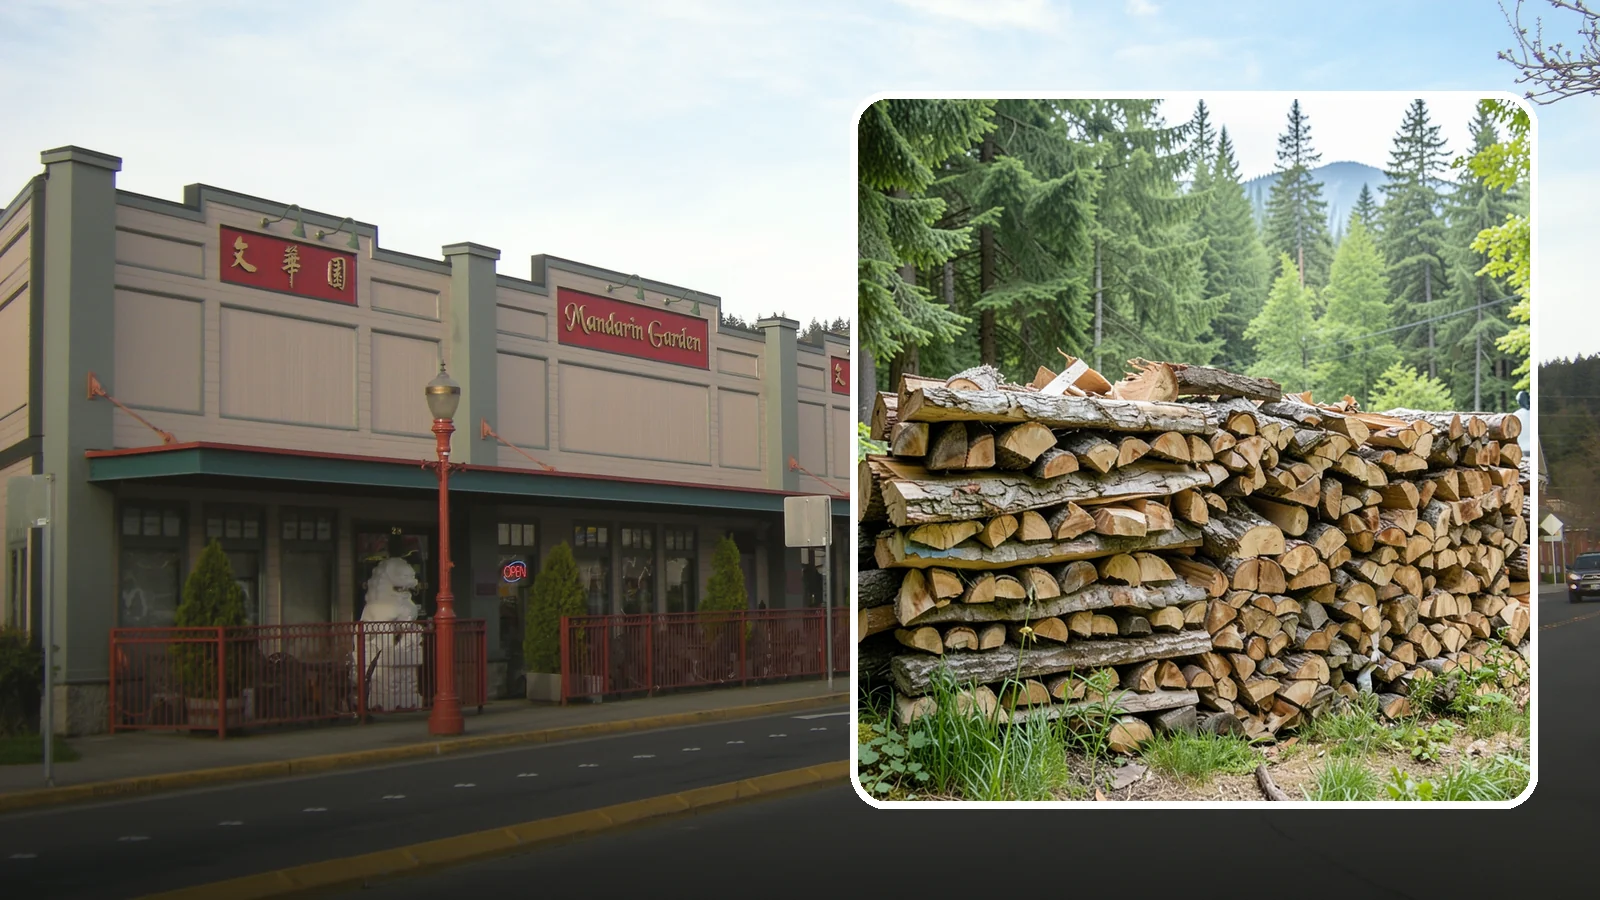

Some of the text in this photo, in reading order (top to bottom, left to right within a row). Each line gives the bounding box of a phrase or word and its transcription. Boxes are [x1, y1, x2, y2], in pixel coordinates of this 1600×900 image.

[230, 235, 346, 291] 文華園
[564, 302, 701, 352] Mandarin Garden
[834, 363, 846, 386] 文
[503, 565, 527, 578] OPEN
